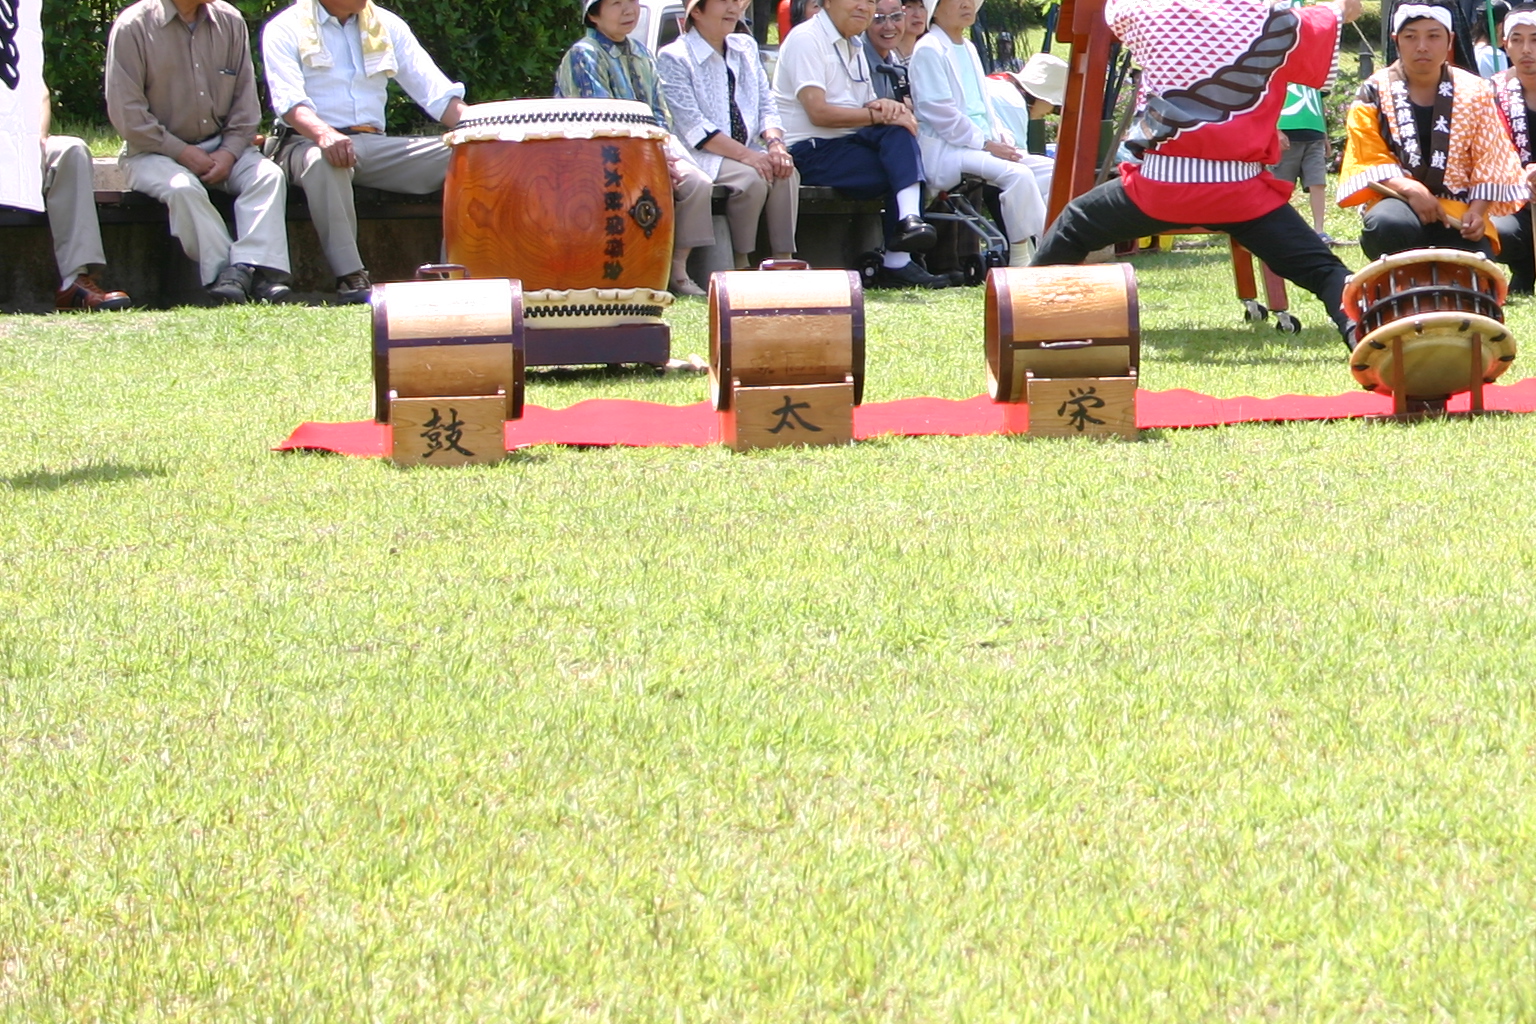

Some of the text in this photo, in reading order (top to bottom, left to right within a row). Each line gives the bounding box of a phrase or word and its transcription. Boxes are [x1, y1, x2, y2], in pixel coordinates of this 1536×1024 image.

[1430, 81, 1453, 170] 栄太鼓
[419, 407, 475, 458] 鼓
[764, 395, 824, 434] 太
[1057, 386, 1106, 432] 栄
